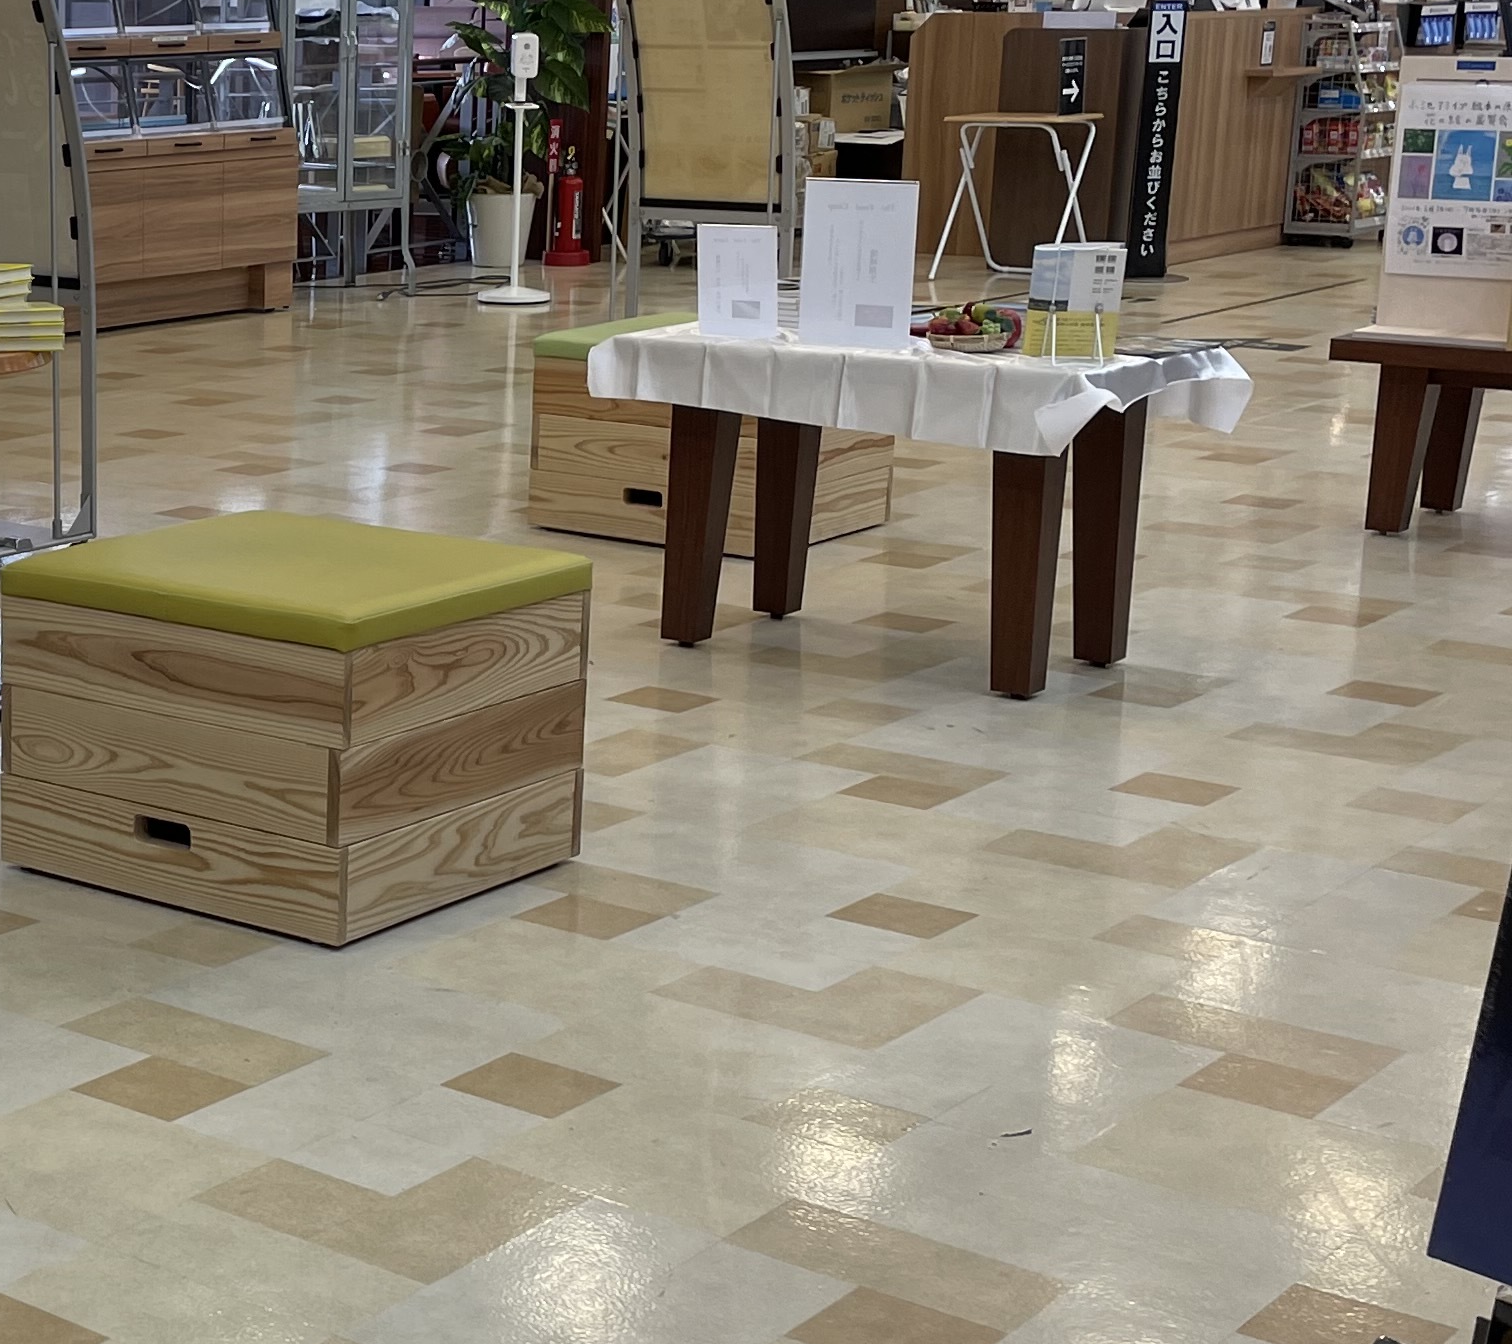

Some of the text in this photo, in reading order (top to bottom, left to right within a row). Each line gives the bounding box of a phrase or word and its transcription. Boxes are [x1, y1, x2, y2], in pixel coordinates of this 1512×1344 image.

[1155, 12, 1179, 61] 入口
[1139, 70, 1170, 257] こちらからお並びください
